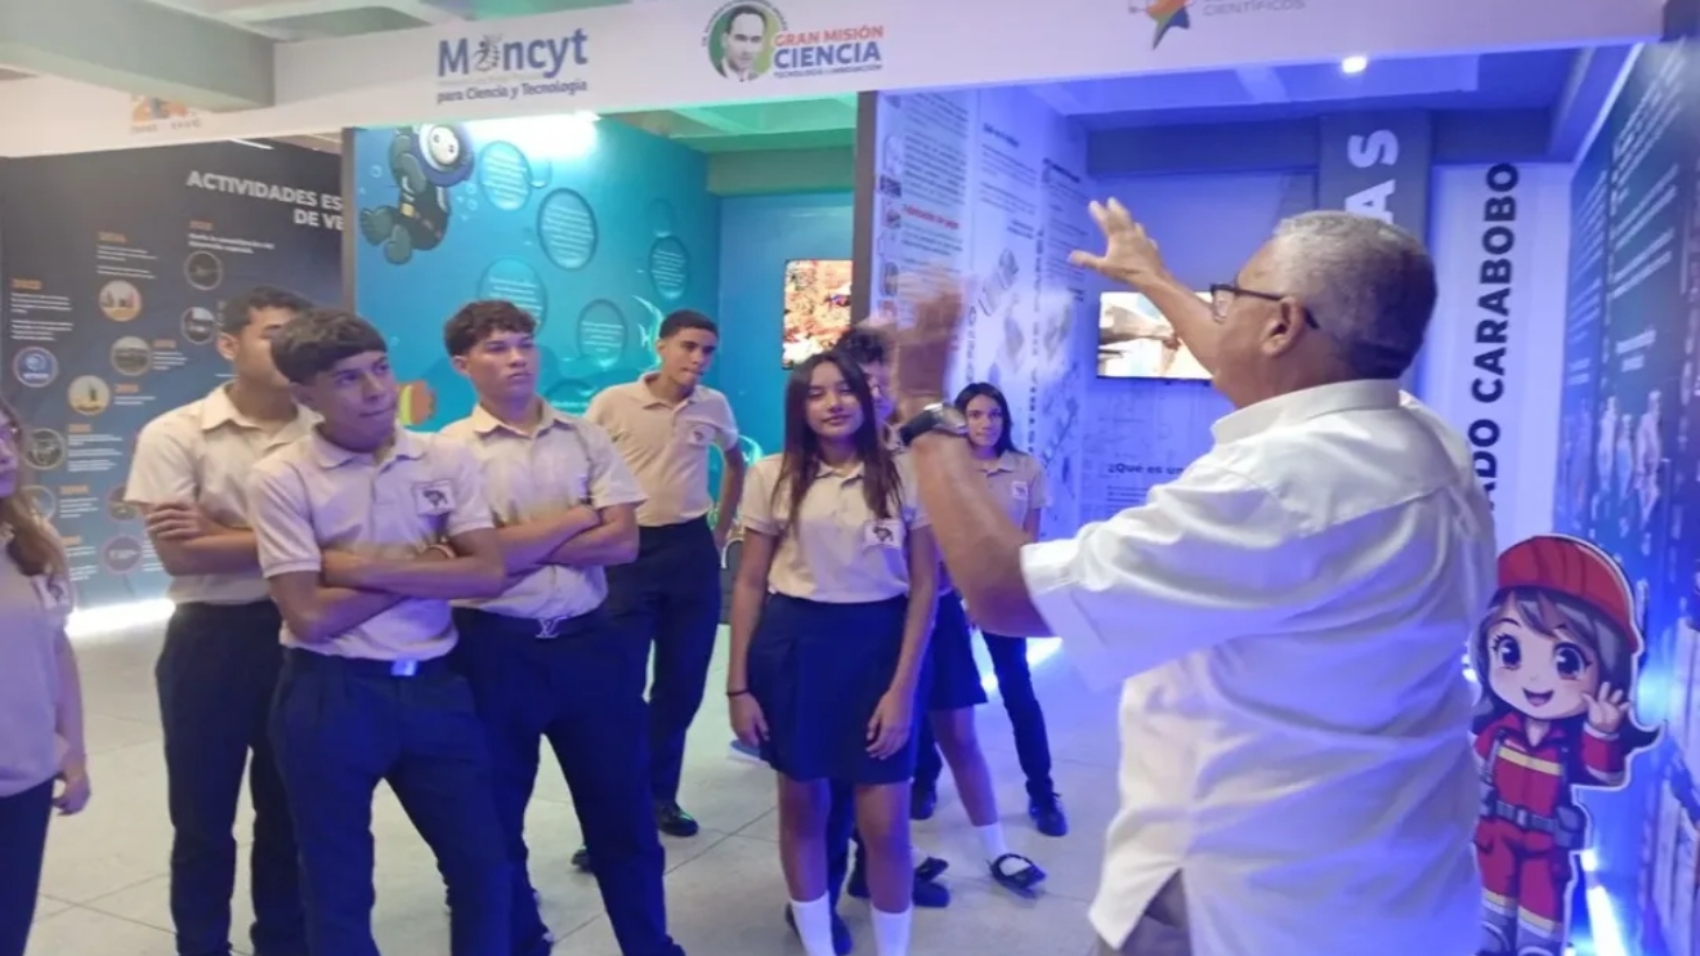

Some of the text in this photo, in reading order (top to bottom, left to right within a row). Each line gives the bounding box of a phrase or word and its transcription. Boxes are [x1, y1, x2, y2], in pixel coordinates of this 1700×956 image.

[773, 24, 884, 47] GRAN MISIÓN
[773, 41, 881, 70] CIENCIA
[437, 91, 463, 105] para
[466, 86, 508, 101] Ciencia
[510, 86, 518, 99] y
[186, 170, 318, 207] ACTIVIDADES
[293, 208, 319, 227] DE
[1471, 162, 1520, 404] CARABOBO
